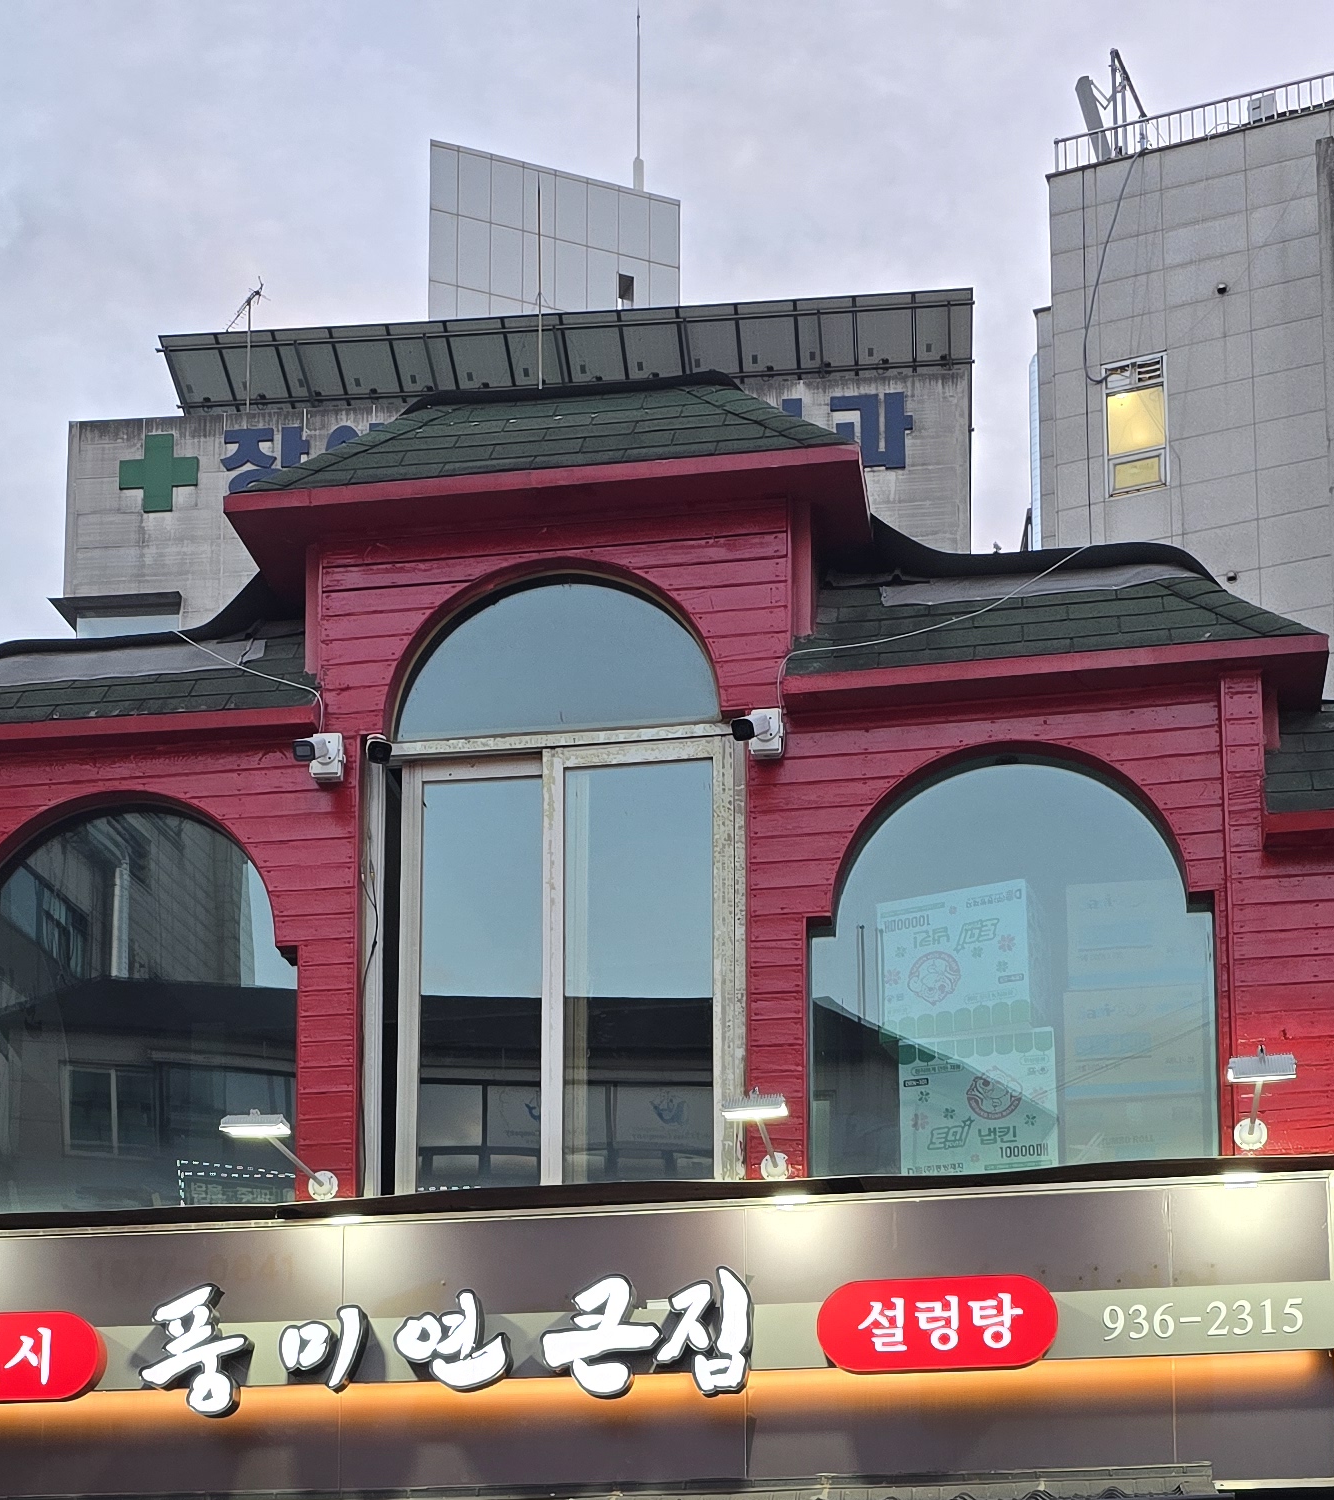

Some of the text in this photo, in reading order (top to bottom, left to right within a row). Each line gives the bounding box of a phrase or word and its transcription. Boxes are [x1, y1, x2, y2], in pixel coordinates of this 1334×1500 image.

[139, 1282, 512, 1416] 풍미연
[858, 1294, 1025, 1353] 설렁탕
[1101, 1296, 1306, 1345] 936-2315
